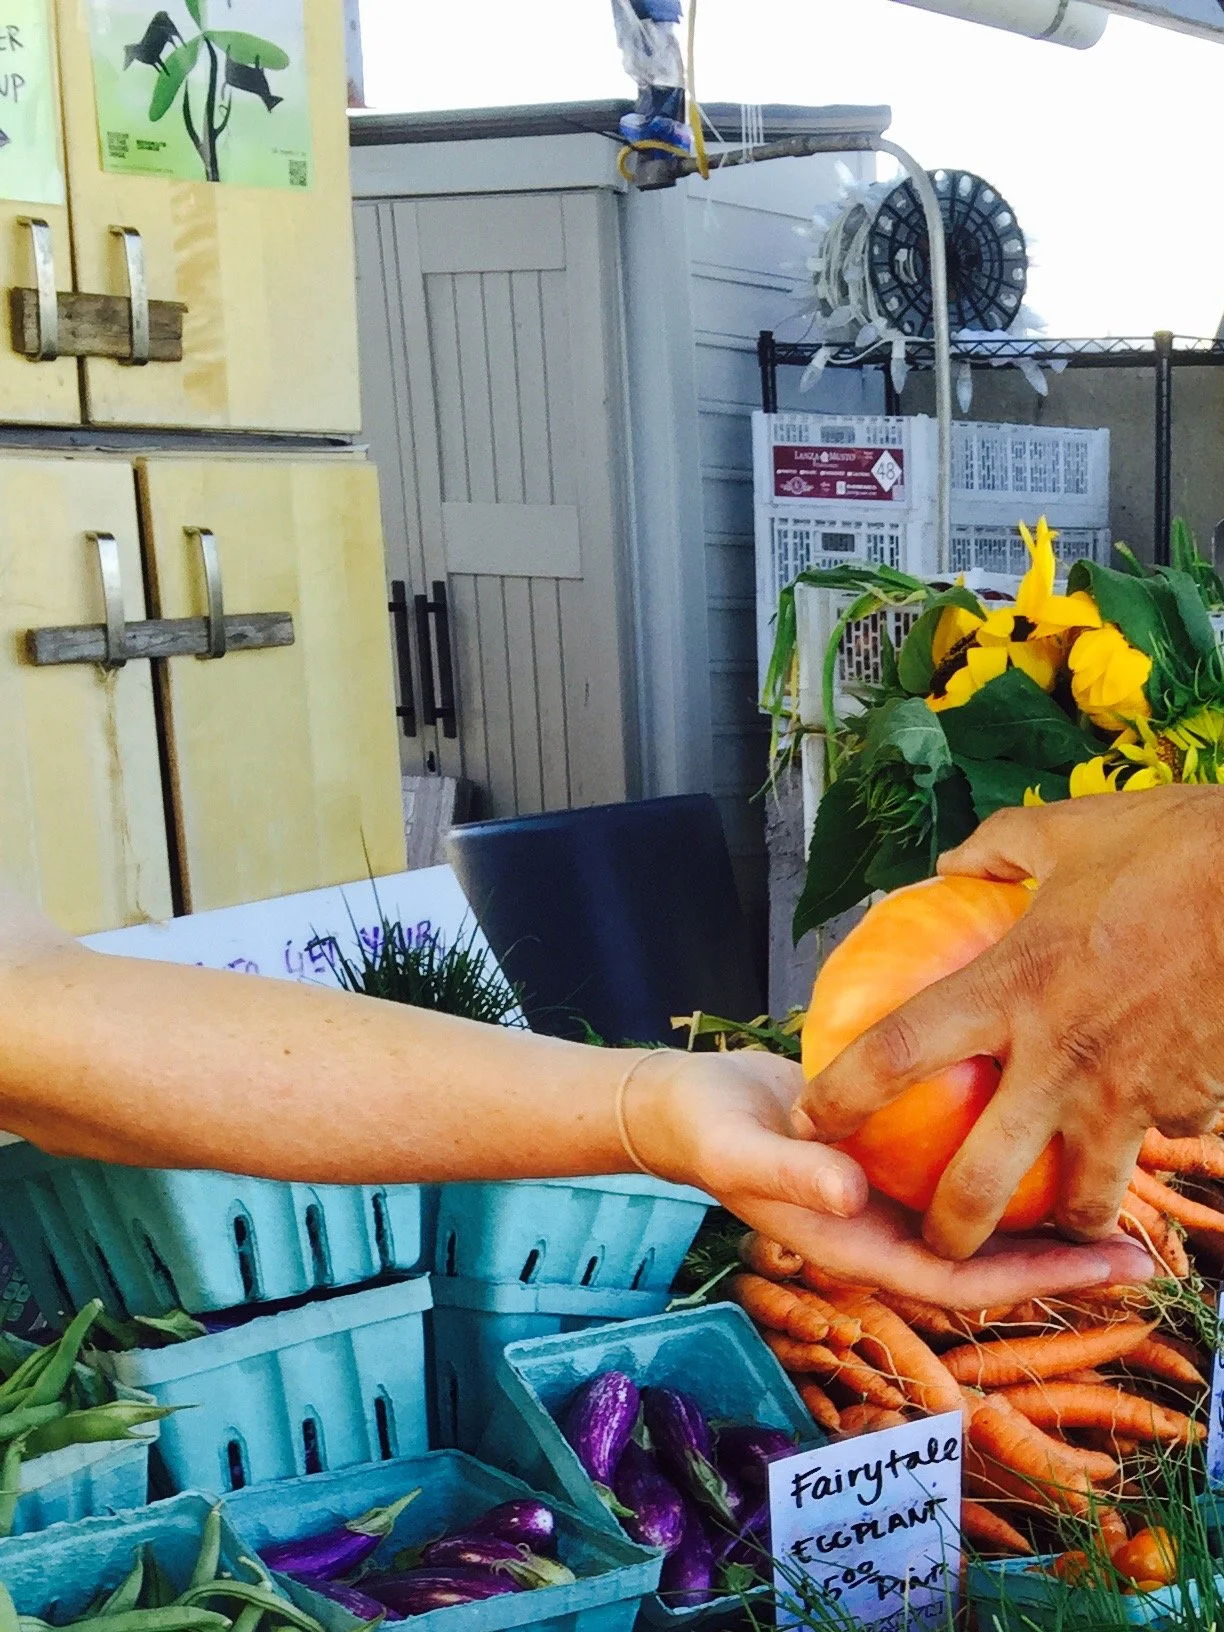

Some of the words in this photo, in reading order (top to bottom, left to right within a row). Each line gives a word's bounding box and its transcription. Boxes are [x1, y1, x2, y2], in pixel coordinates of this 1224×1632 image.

[876, 462, 896, 481] 48
[359, 919, 434, 972] YUR
[790, 1437, 960, 1509] Fairytale
[790, 1497, 949, 1564] EGGPLANT
